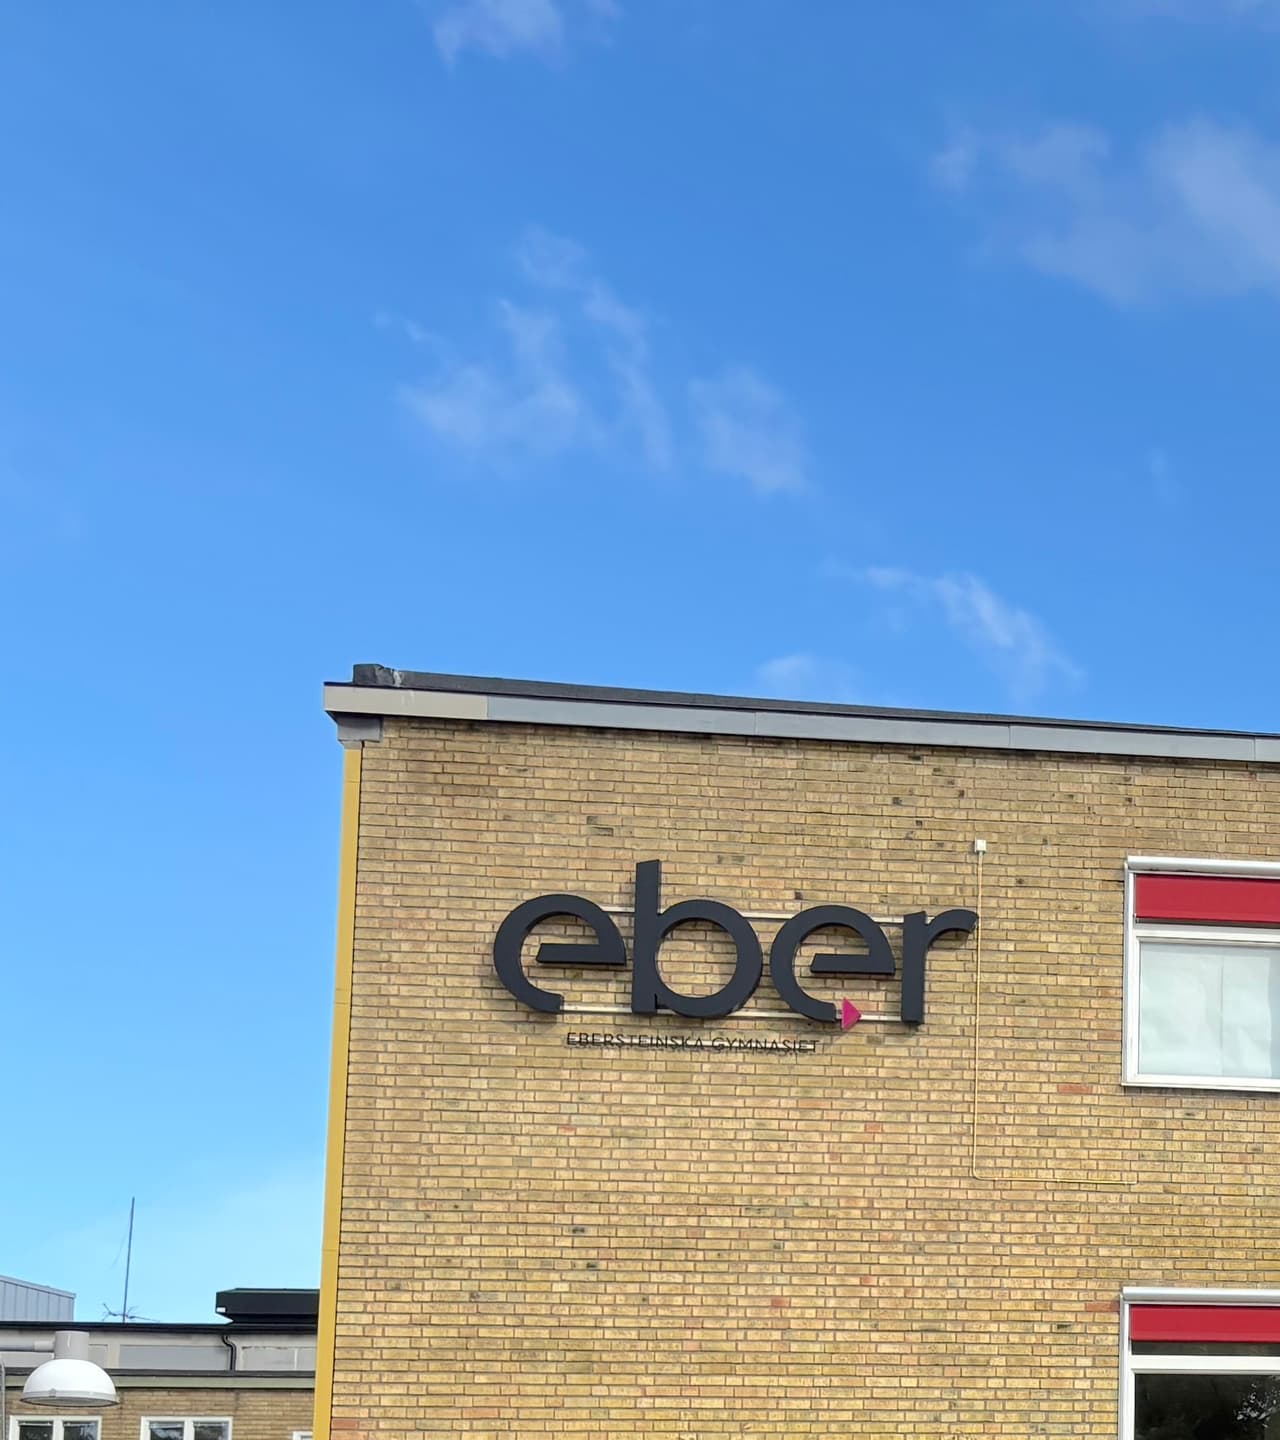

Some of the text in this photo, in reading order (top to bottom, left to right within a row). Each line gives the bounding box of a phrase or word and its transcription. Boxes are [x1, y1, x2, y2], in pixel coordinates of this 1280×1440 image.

[493, 859, 979, 1025] eber
[566, 1031, 820, 1054] EBERSTEINSKA GYMNASIET
